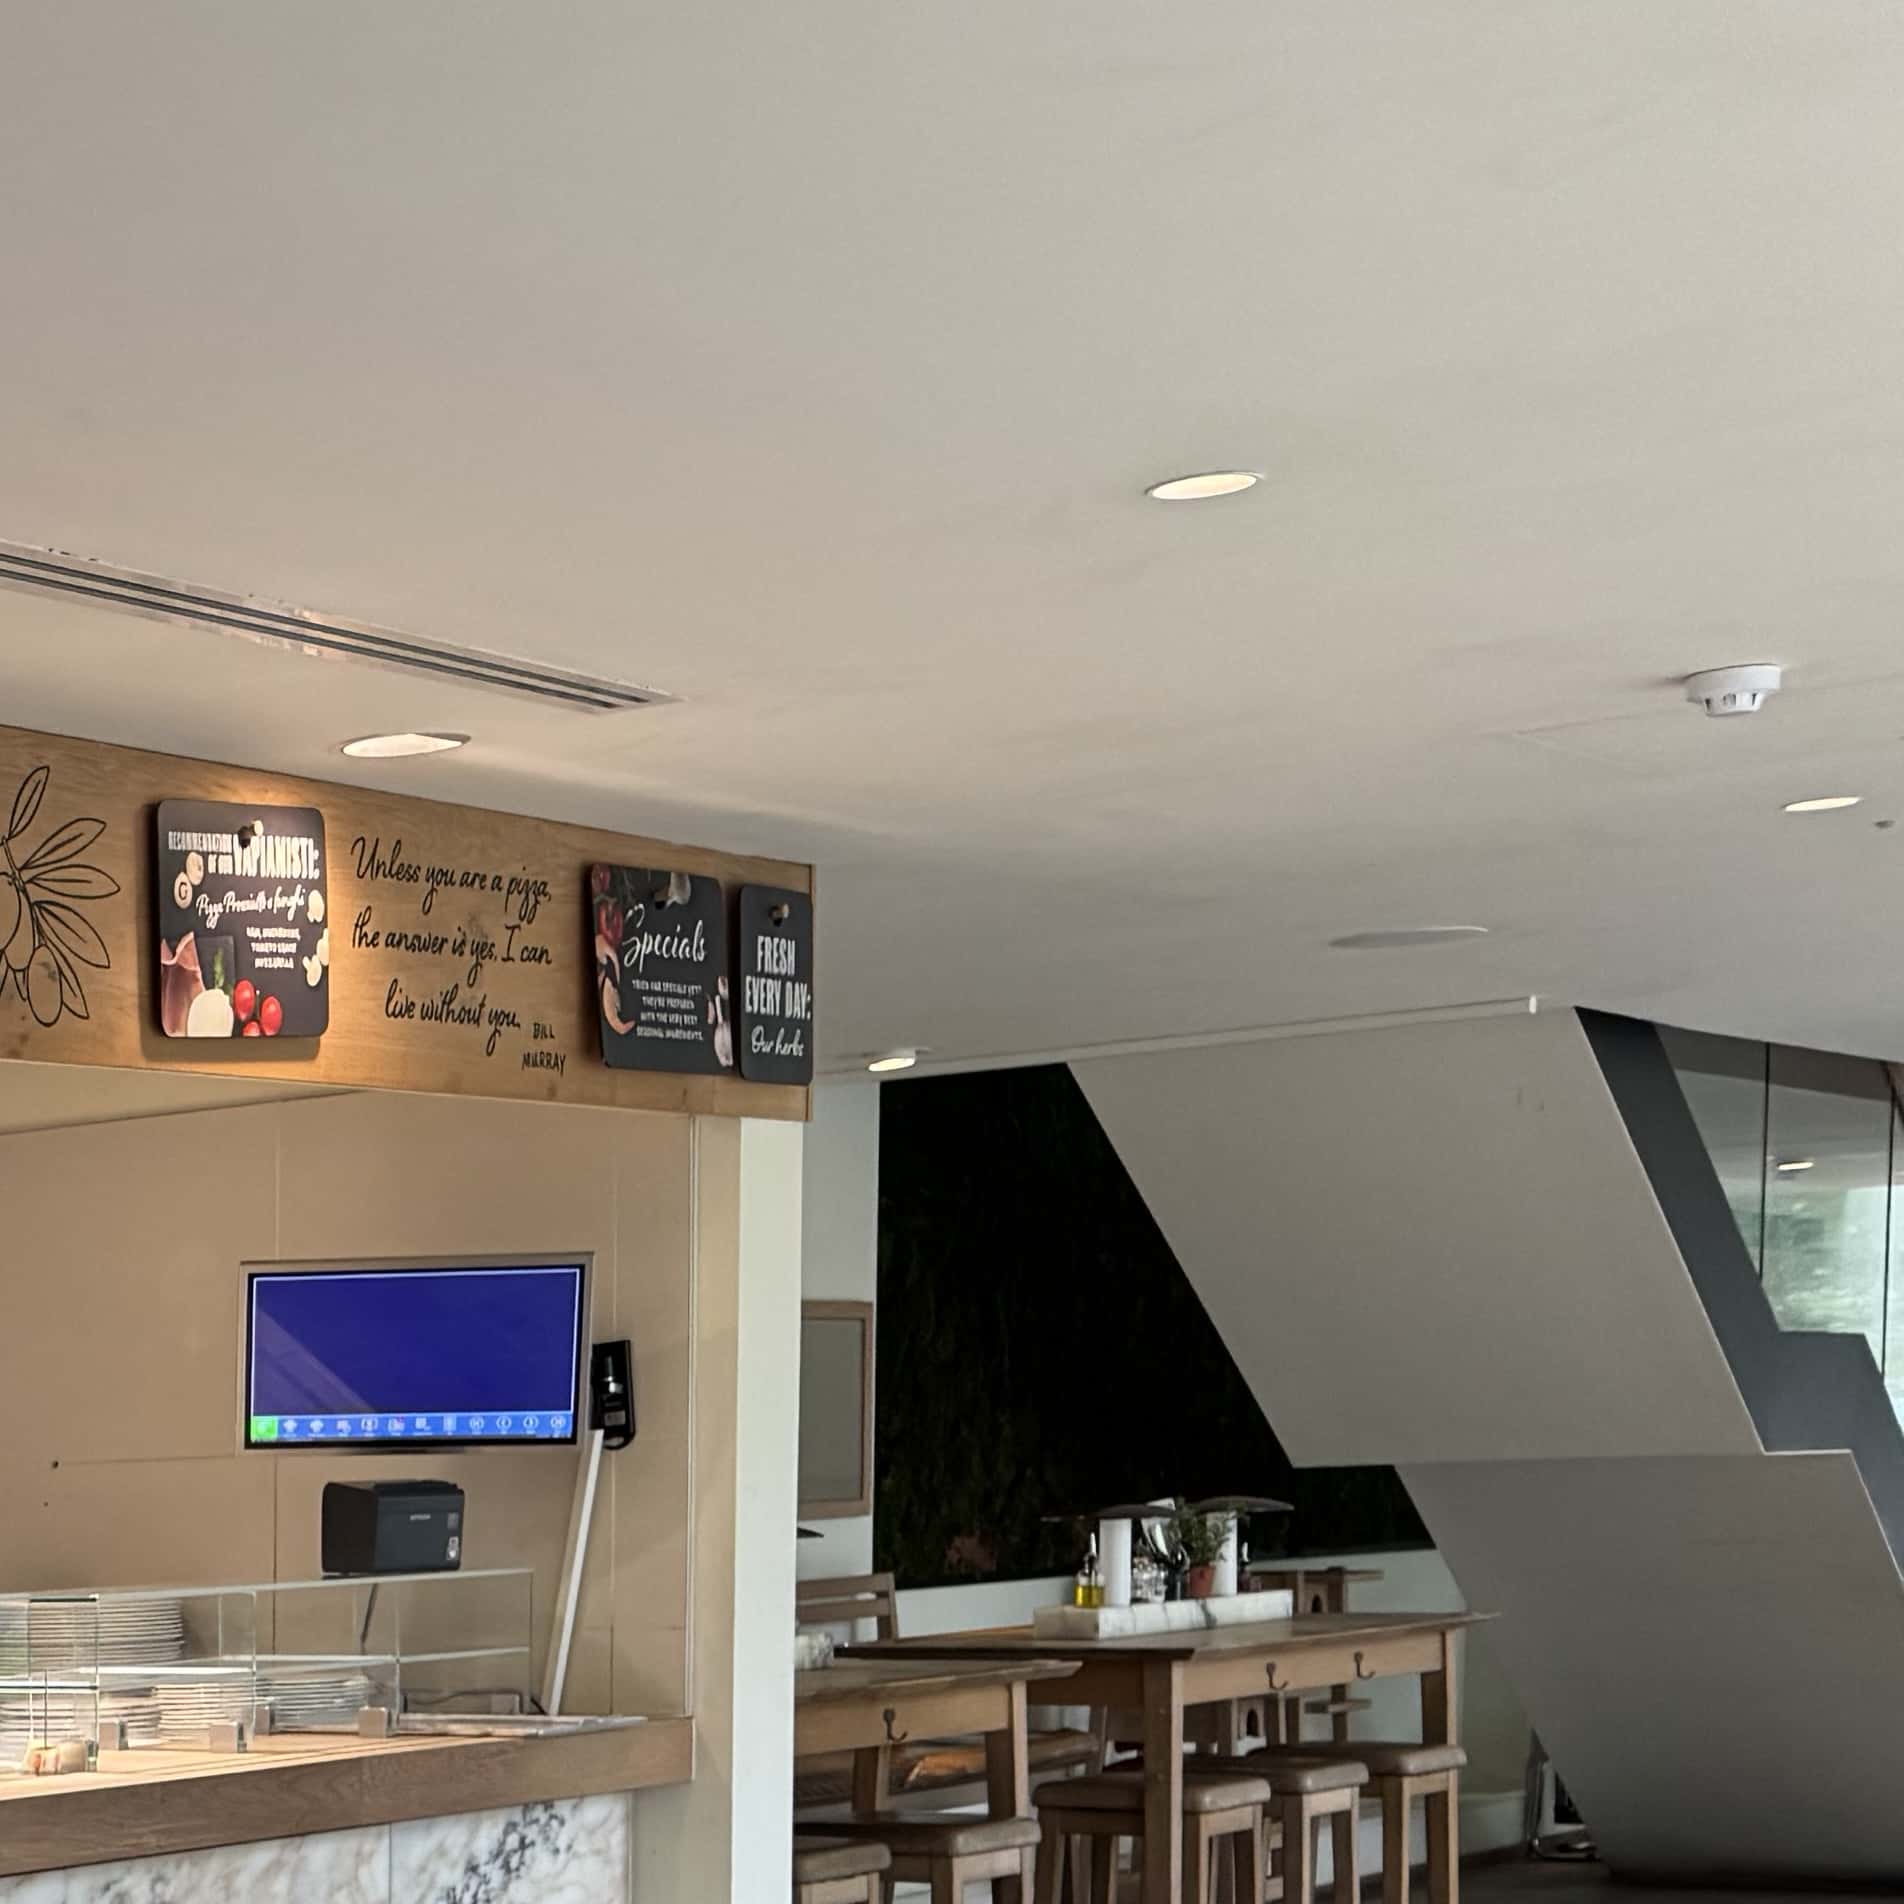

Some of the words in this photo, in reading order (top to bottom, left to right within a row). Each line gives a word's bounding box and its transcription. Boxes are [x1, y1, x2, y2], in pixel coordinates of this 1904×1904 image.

[351, 836, 421, 883] Unless
[422, 867, 456, 915] you
[459, 872, 487, 890] are
[491, 875, 502, 892] a
[505, 866, 551, 924] pizza,
[353, 905, 380, 948] the
[385, 932, 448, 954] answer
[452, 926, 466, 957] is
[467, 939, 497, 988] yes.
[501, 924, 521, 962] I
[520, 946, 552, 964] can
[622, 904, 707, 973] Specials
[757, 935, 795, 975] FRESH
[385, 978, 416, 1019] live
[421, 983, 486, 1027] without
[745, 976, 781, 1016] EVERY
[785, 981, 811, 1020] DAY:
[533, 1022, 555, 1040] BILL
[751, 1025, 773, 1053] Our
[775, 1027, 803, 1057] herbs
[522, 1051, 566, 1076] MURRAY
